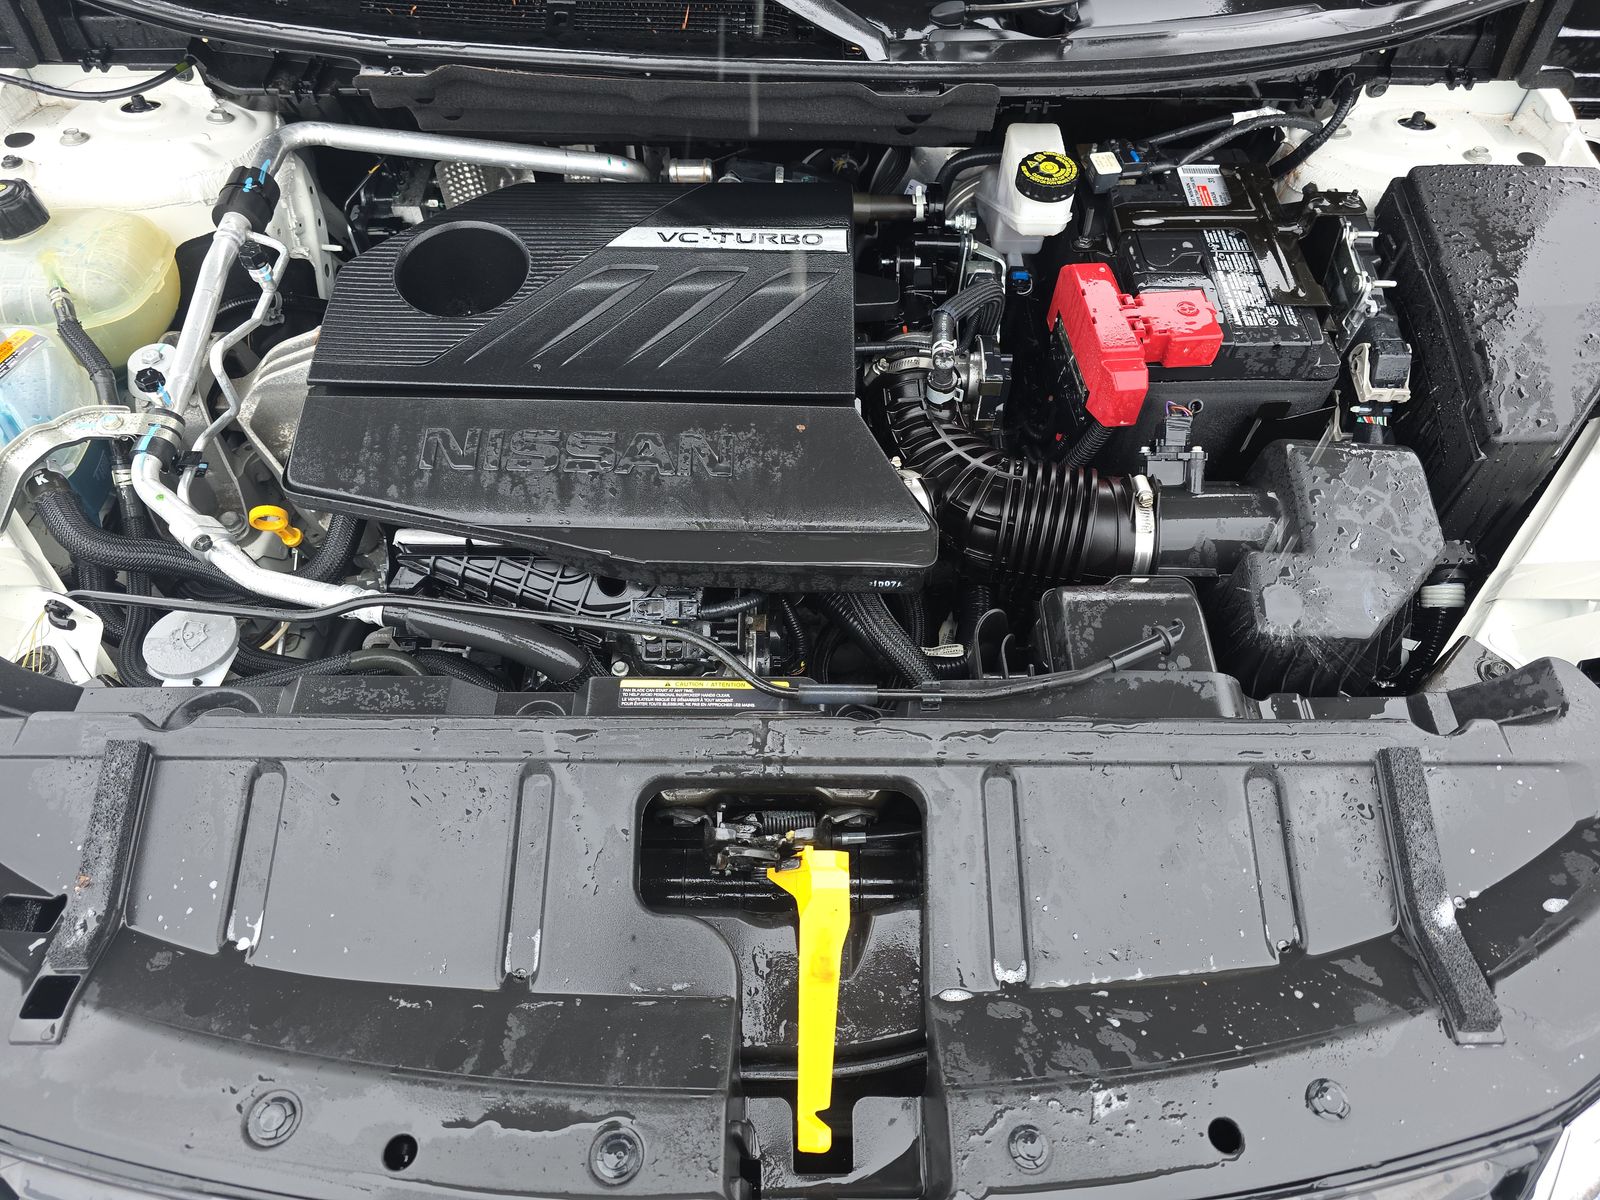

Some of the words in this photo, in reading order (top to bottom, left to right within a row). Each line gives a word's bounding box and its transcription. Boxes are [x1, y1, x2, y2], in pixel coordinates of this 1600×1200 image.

[657, 231, 823, 245] VC-TURBO
[418, 427, 734, 477] NISSAN
[34, 473, 49, 486] K
